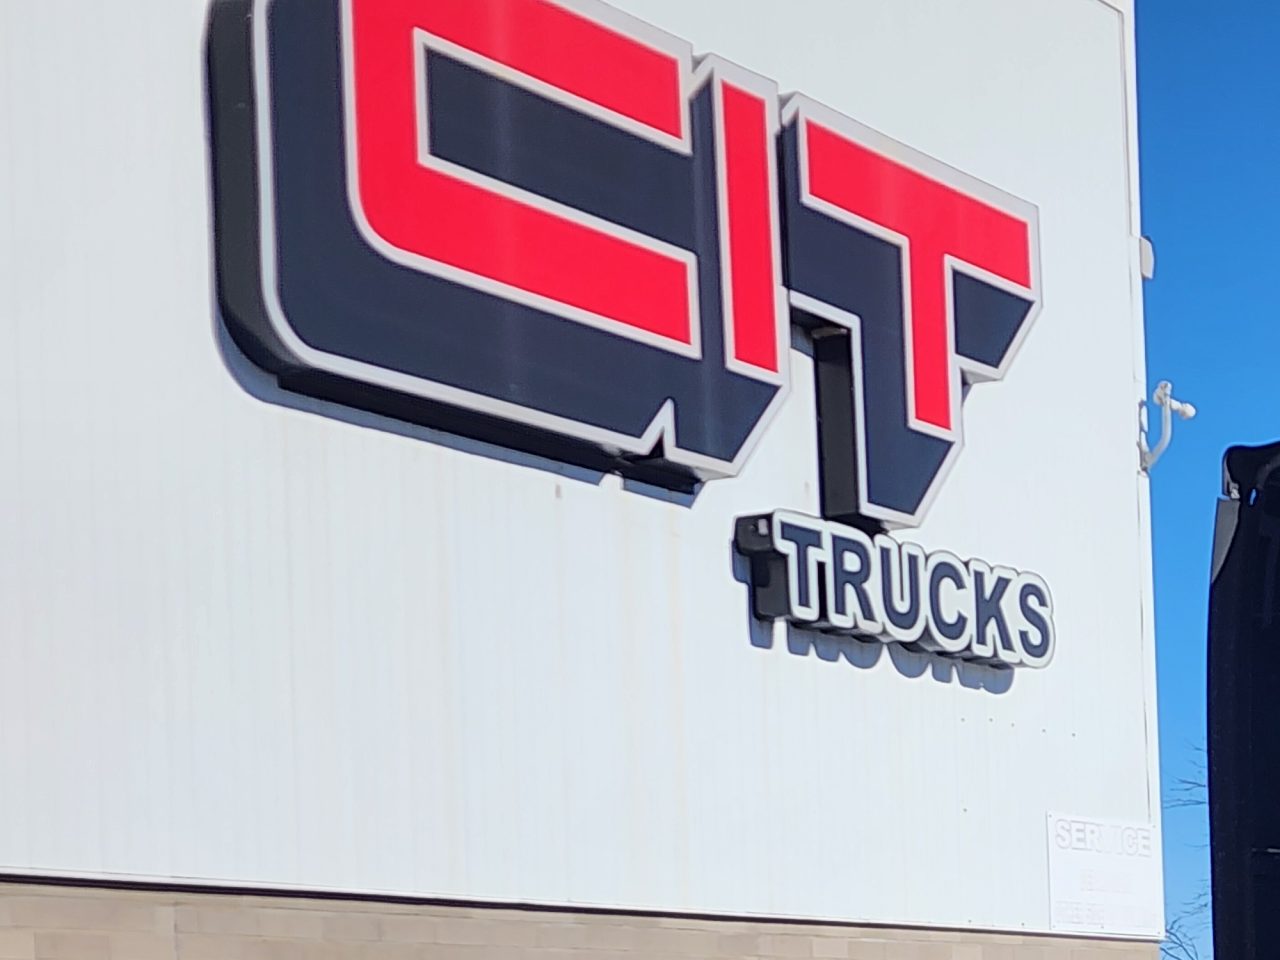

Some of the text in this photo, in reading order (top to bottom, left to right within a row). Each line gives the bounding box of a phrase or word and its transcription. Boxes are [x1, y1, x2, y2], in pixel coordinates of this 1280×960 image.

[255, 0, 1040, 525] CIT
[776, 514, 1054, 664] TRUCKS
[1055, 818, 1152, 858] SERCE
